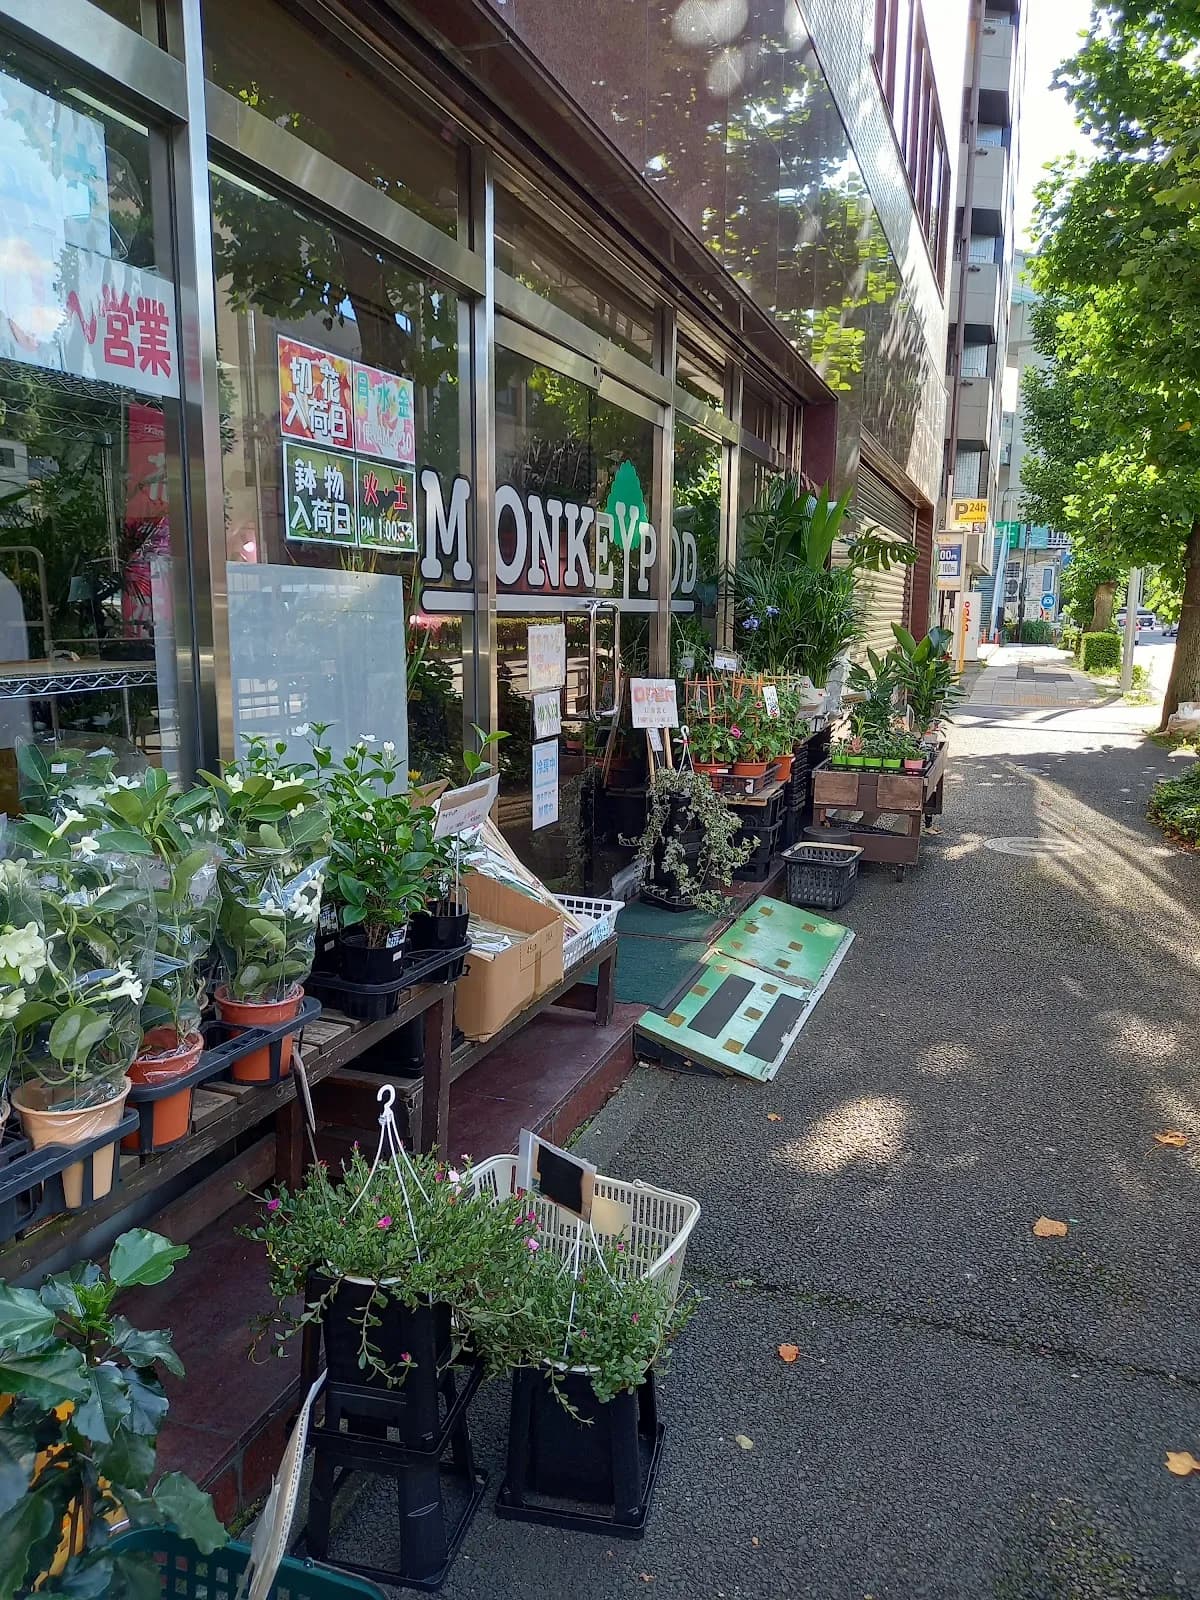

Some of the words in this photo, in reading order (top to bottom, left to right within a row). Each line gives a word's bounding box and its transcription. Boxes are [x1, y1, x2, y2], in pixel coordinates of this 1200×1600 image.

[290, 355, 341, 403] 切花
[285, 391, 348, 440] 入荷日
[294, 458, 345, 501] 鉢物
[290, 495, 351, 536] 入荷日
[360, 515, 375, 537] PM
[955, 502, 969, 520] P
[969, 503, 987, 512] 24h
[420, 467, 641, 600] MONKEY
